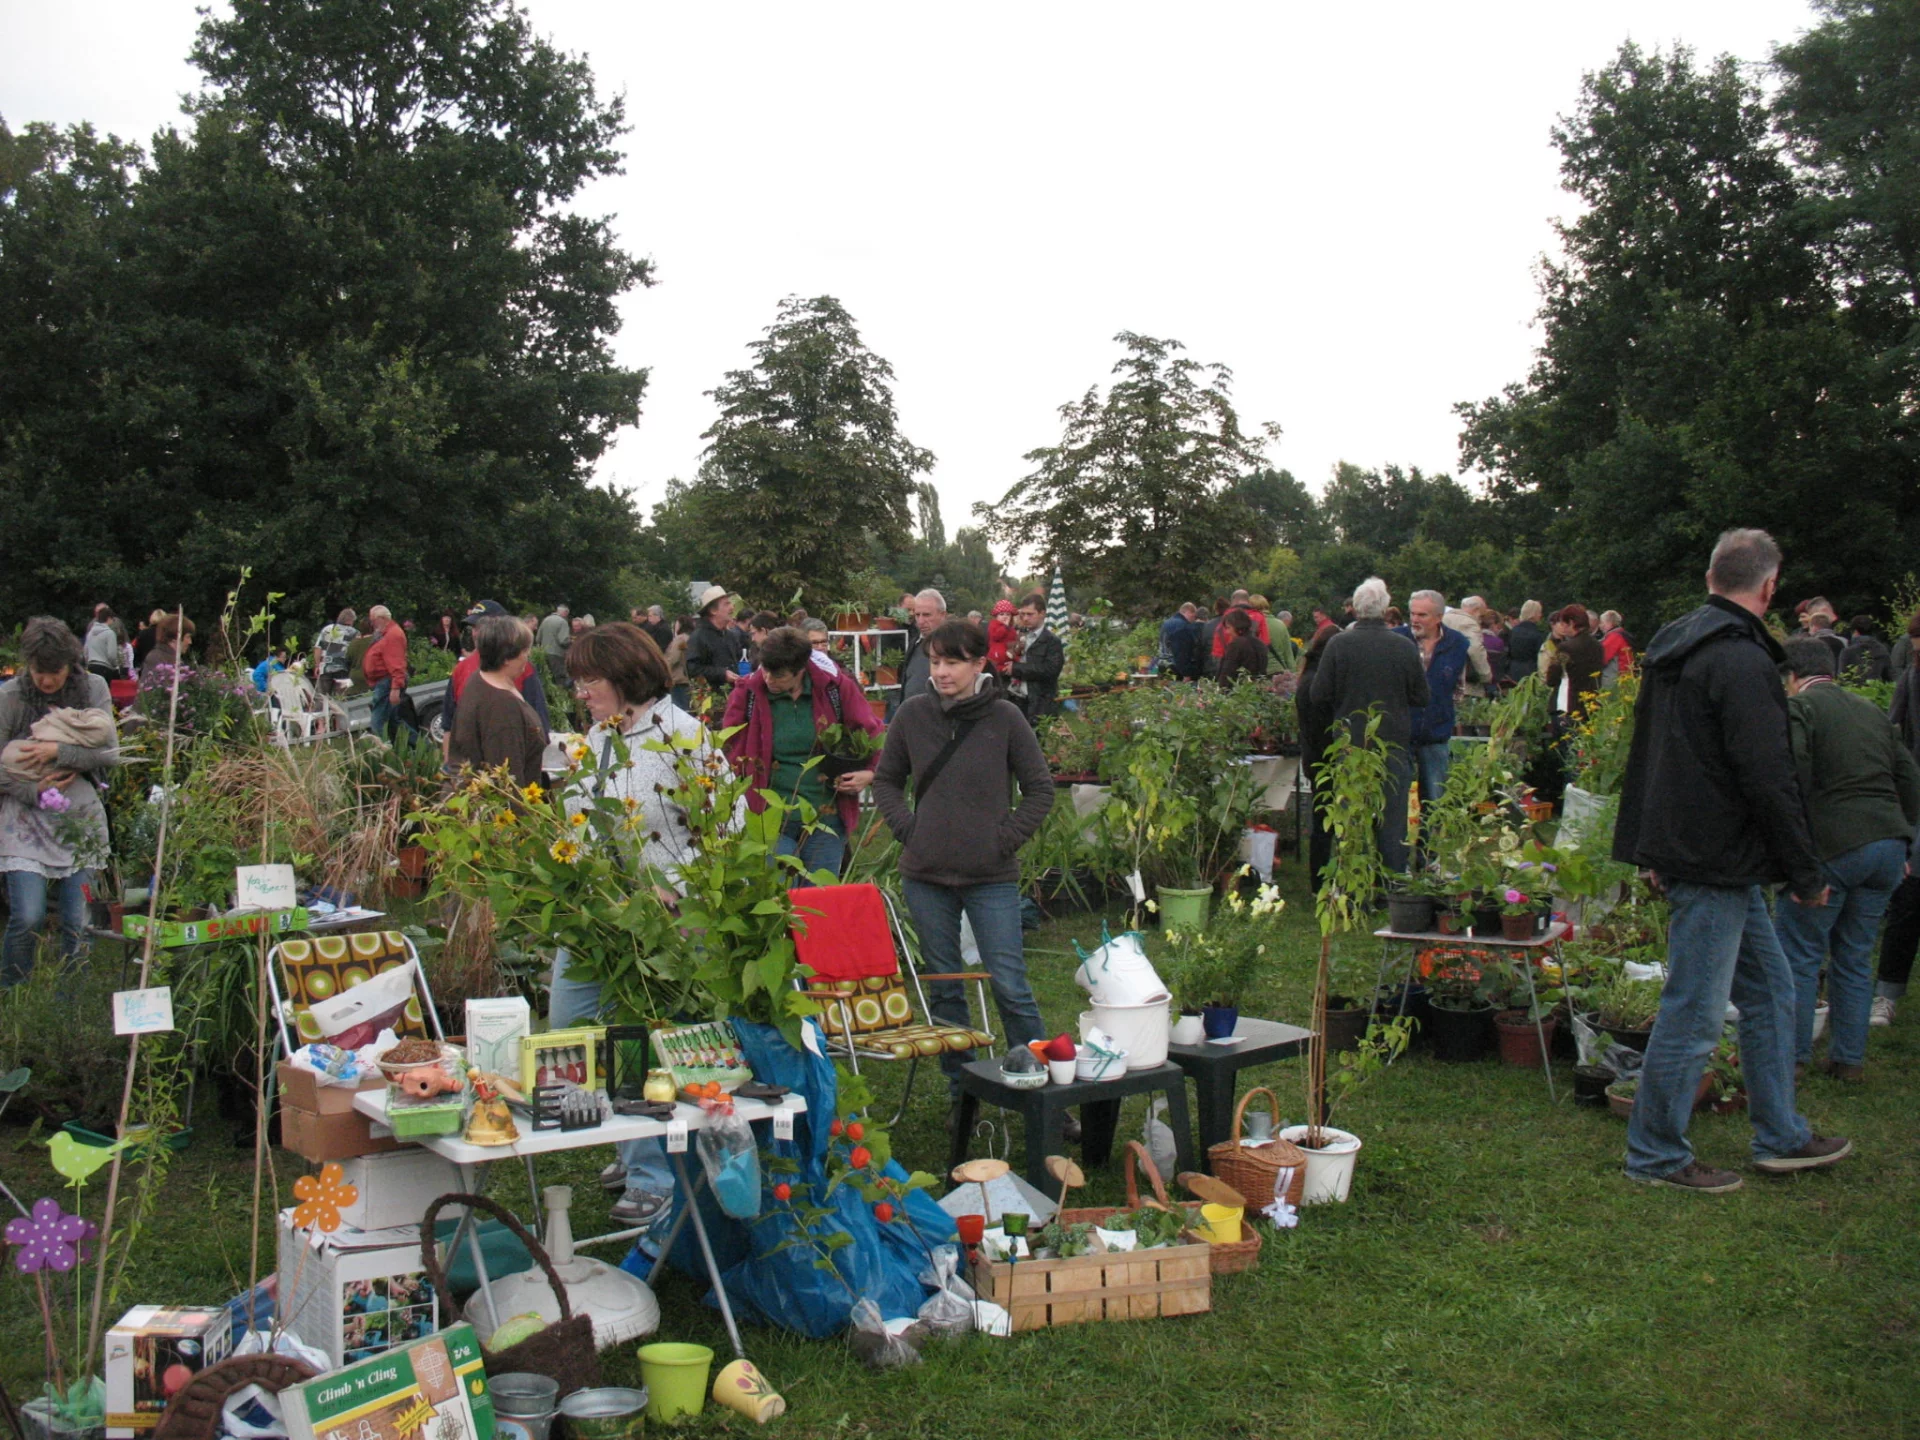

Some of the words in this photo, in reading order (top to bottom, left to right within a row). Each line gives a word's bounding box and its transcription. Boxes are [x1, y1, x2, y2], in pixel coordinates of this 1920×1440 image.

[317, 1382, 352, 1404] Climb
[355, 1378, 365, 1390] 'n
[367, 1367, 397, 1385] Cling
